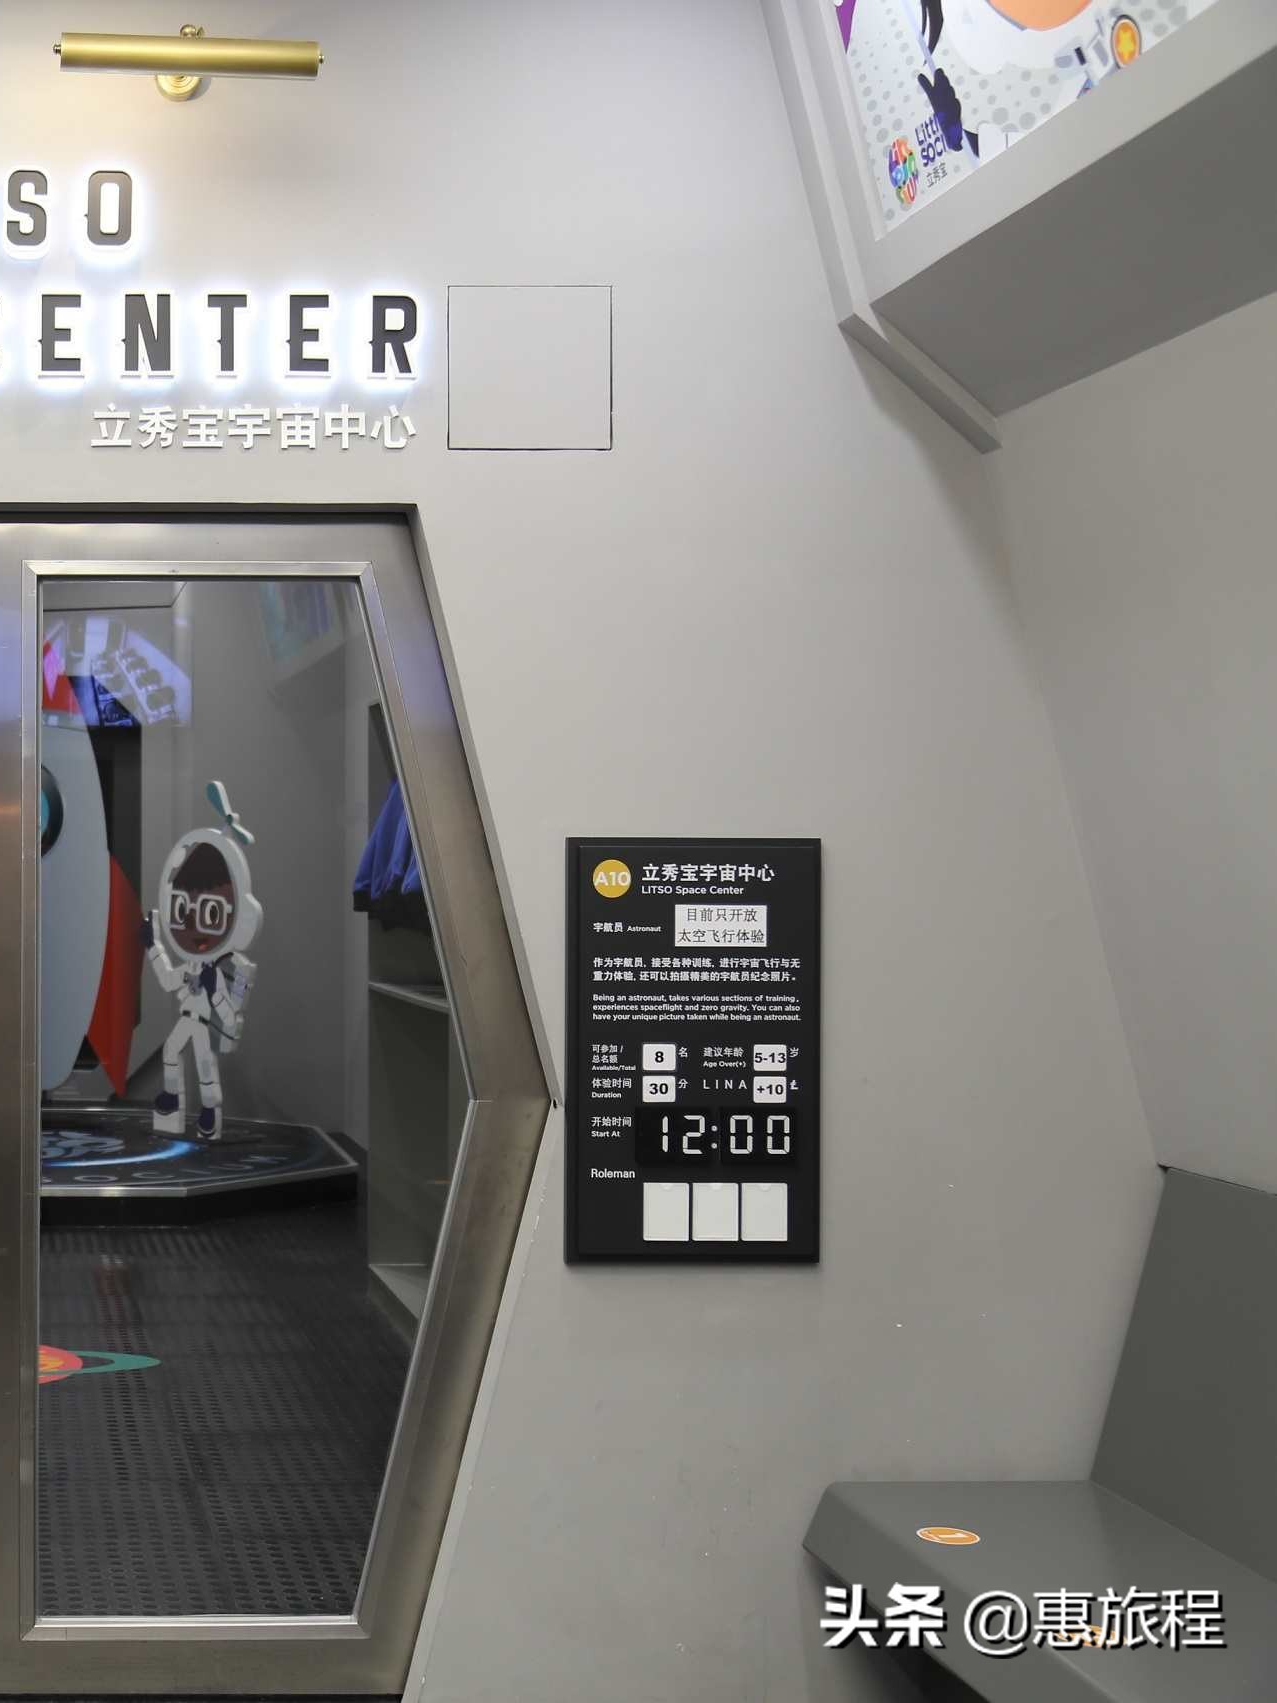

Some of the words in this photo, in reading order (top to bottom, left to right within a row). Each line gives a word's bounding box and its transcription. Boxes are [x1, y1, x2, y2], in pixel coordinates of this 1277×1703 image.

[90, 403, 417, 451] 立秀宝宇宙中心
[593, 871, 632, 887] A10
[641, 863, 776, 883] 立秀宝宇宙中心
[641, 885, 673, 895] LITSO
[675, 885, 707, 896] Space
[709, 885, 745, 895] Center
[686, 907, 758, 922] 目前只开放
[592, 921, 624, 933] 宇航员
[677, 928, 765, 943] 太空飞行体验
[592, 993, 615, 1002] Being
[628, 994, 667, 1002] astronaut,
[668, 994, 690, 1002] takes
[592, 1003, 639, 1012] experiences
[640, 1003, 683, 1012] spaceflight
[720, 1004, 750, 1013] gravity.
[784, 1004, 801, 1012] also
[631, 1013, 658, 1021] unique
[658, 1013, 685, 1021] picture
[730, 1013, 752, 1022] being
[763, 1013, 801, 1021] astronaut.
[654, 1050, 665, 1064] 8
[678, 1046, 689, 1058] 名
[703, 1046, 745, 1058] 建议年龄
[754, 1052, 787, 1064] 5-13
[789, 1046, 800, 1058] 岁
[591, 1077, 632, 1089] 体验时间
[649, 1082, 669, 1095] 30
[678, 1078, 689, 1089] 分
[756, 1084, 784, 1095] +10
[591, 1115, 632, 1127] 开始时间
[662, 1114, 791, 1155] 12:00
[590, 1168, 636, 1179] Roleman
